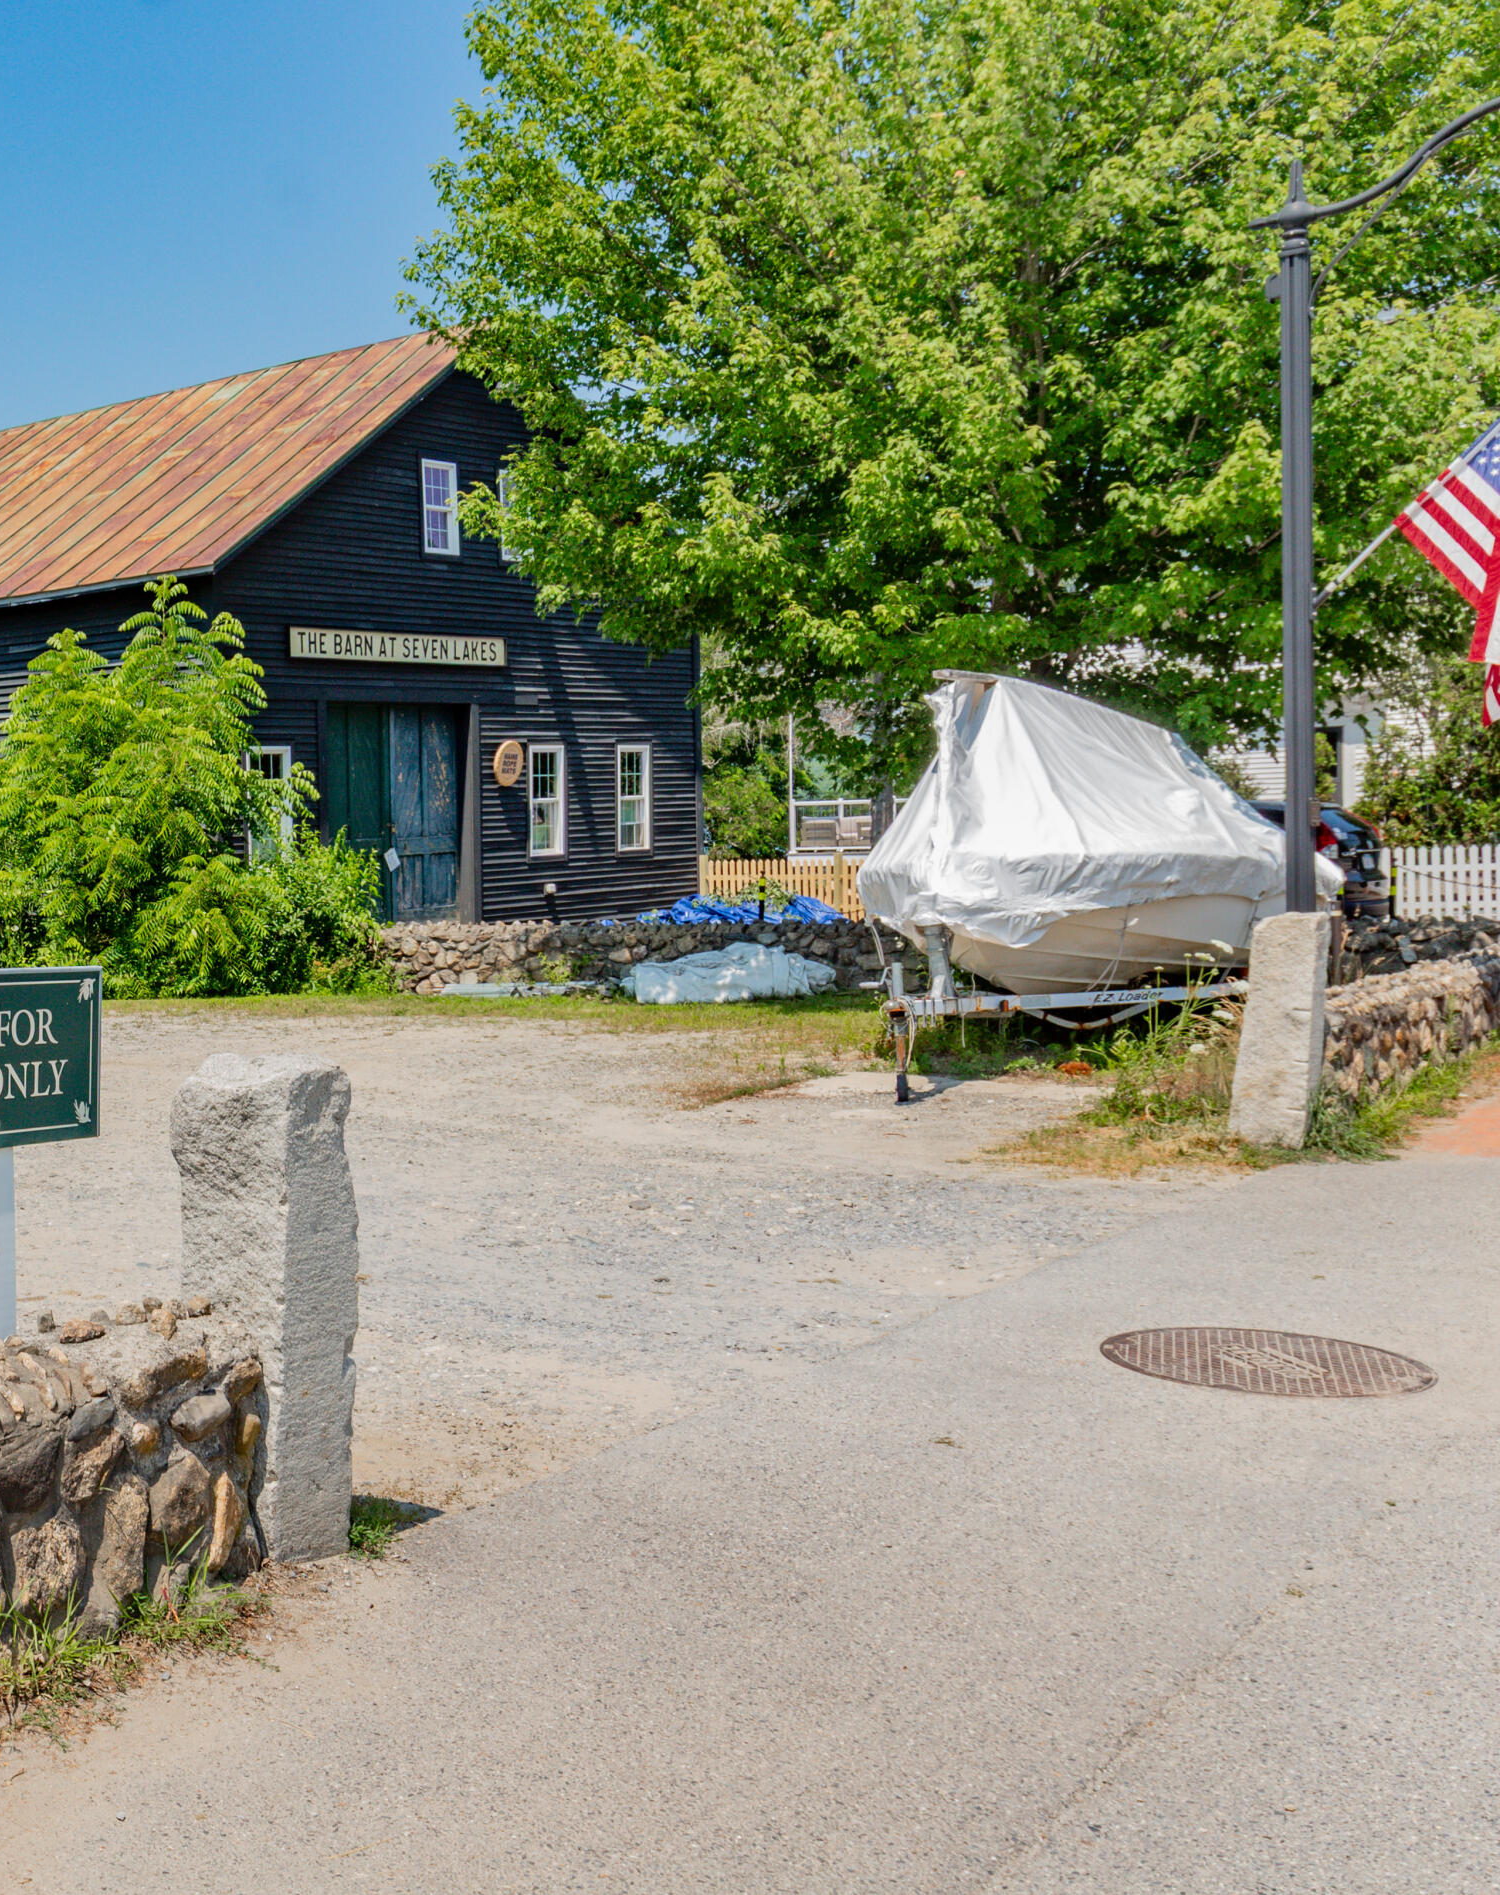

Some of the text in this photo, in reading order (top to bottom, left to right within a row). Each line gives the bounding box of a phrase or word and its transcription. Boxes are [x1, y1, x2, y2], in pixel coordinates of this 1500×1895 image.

[297, 631, 497, 662] THE BARN AT SEVEN LAKES
[1094, 990, 1164, 1003] EZ Loader
